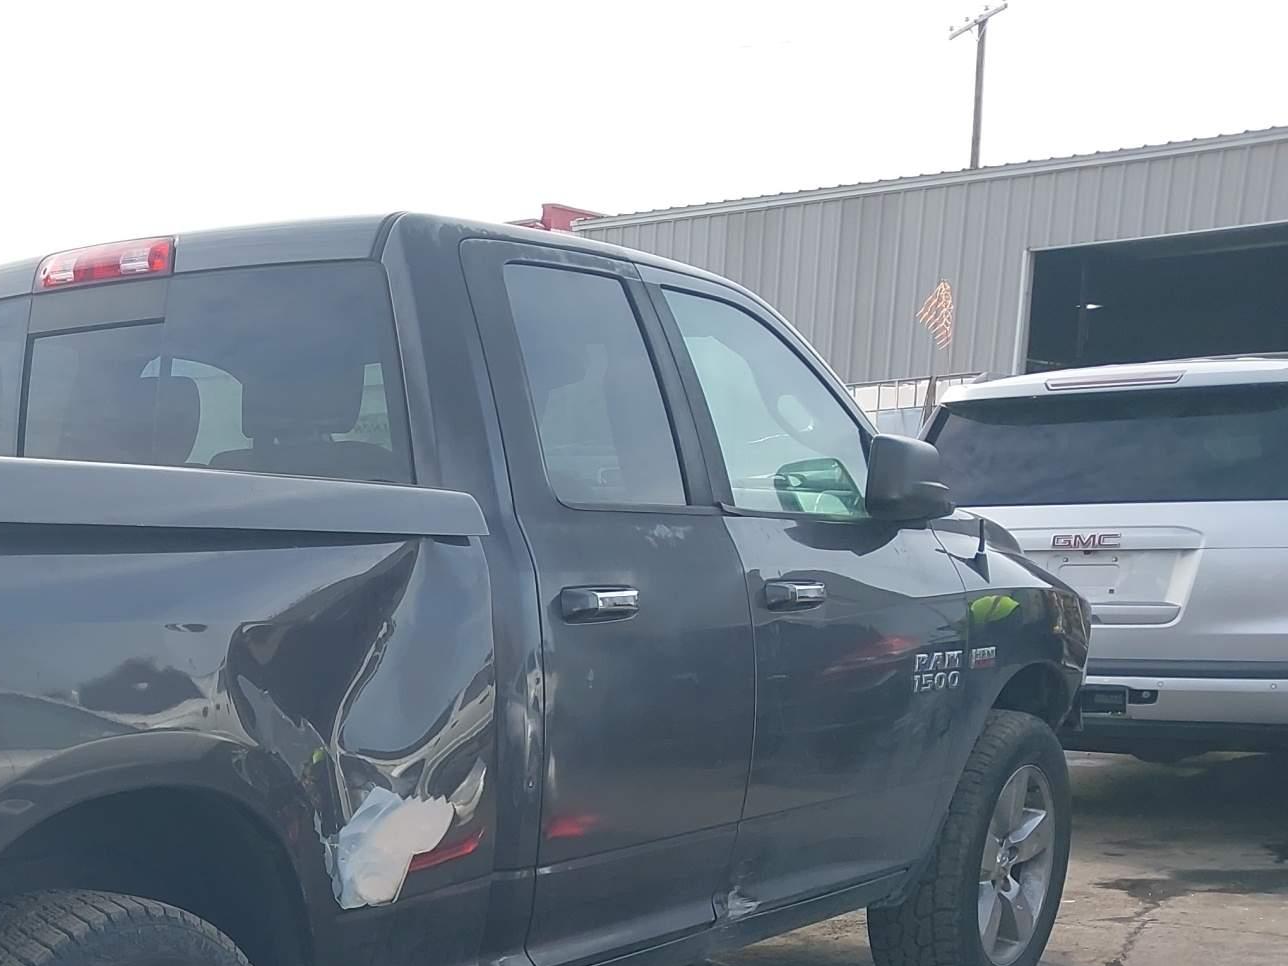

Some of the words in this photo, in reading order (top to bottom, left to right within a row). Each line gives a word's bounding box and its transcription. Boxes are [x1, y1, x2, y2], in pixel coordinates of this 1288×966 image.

[1052, 533, 1121, 549] GMC
[914, 650, 963, 672] RAM
[913, 671, 960, 693] 1500
